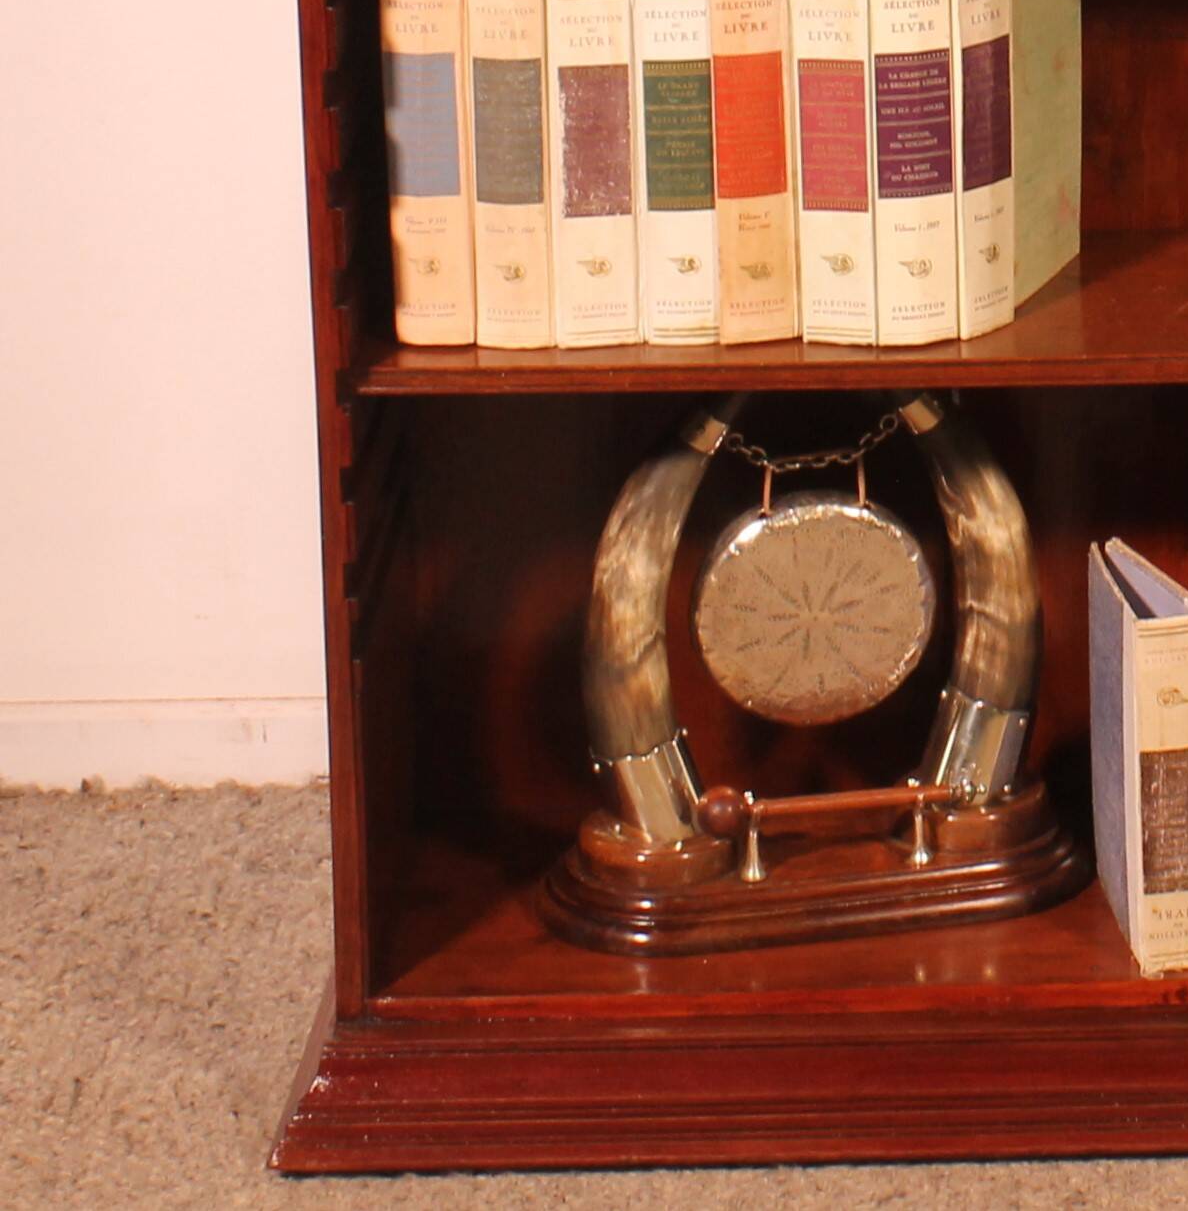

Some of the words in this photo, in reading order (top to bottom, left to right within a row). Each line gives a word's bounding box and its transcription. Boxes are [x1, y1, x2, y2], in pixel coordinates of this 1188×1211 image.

[723, 21, 769, 35] LIVRE
[891, 20, 935, 34] LIVRE
[569, 36, 616, 48] LIVRE
[653, 31, 699, 43] LIVRE
[808, 30, 851, 42] LIVRE
